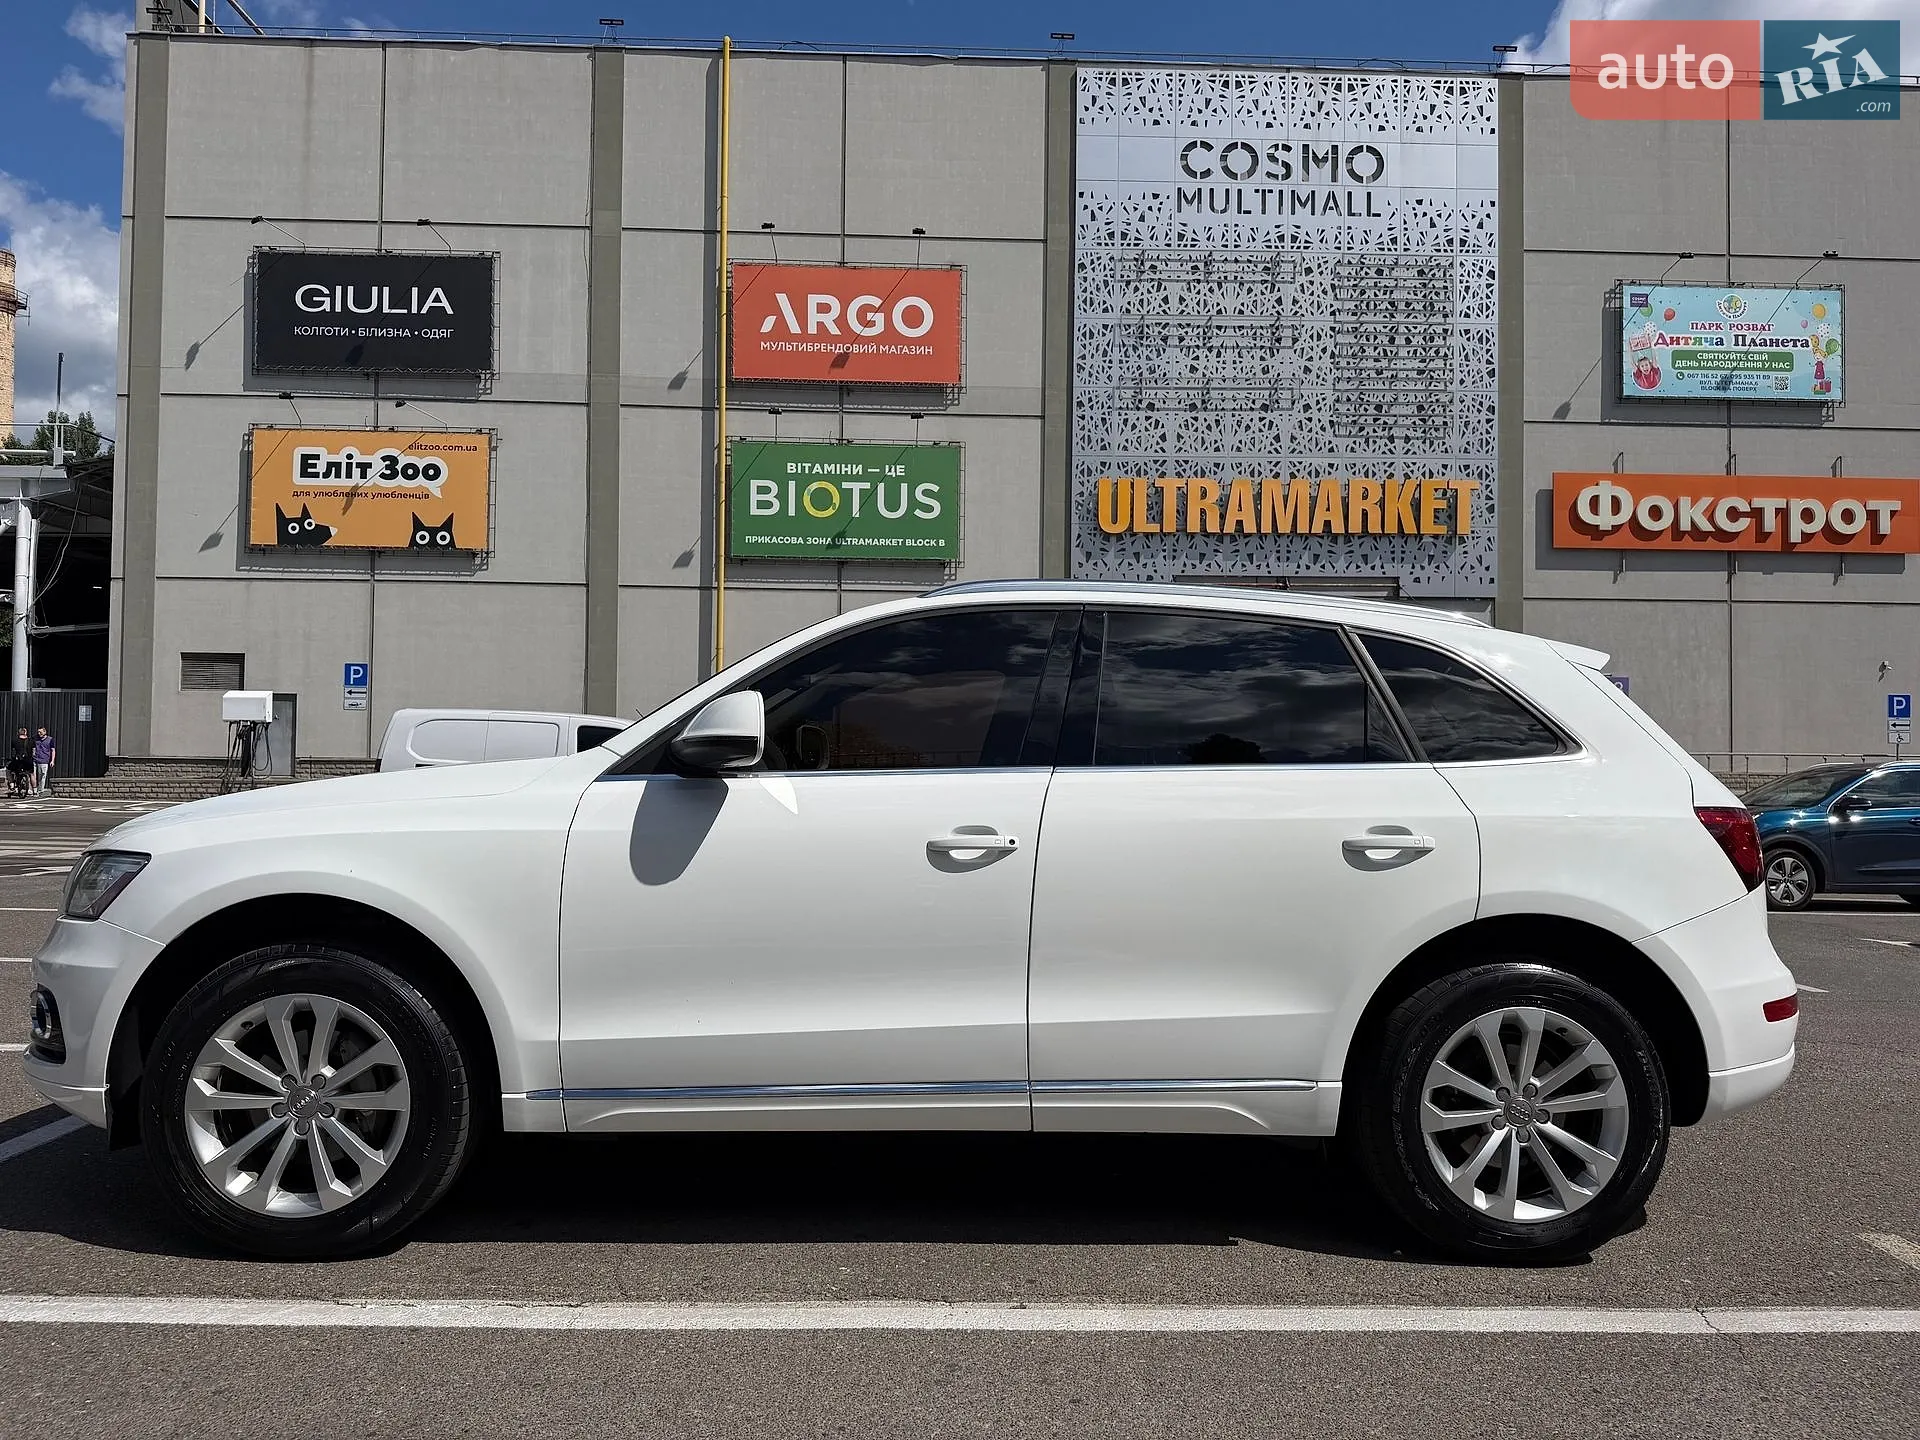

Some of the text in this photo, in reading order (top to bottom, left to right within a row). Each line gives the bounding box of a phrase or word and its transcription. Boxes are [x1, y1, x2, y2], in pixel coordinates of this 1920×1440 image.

[1180, 139, 1384, 184] COSMO
[1176, 186, 1382, 217] MULTIMALL
[294, 283, 454, 315] GIULIA
[759, 292, 934, 338] ARGO
[294, 326, 454, 339] КОЛГОТИ БІЛИЗНА ОДЯГ
[1690, 321, 1775, 333] ПАРК РОЗВАГ
[760, 341, 933, 356] МУЛЬТИБРЕНДОВИЙ МАГАЗИН
[1653, 333, 1725, 348] Дитяча
[1733, 334, 1810, 349] Планета
[1675, 359, 1790, 369] ДЕНЬ НАРОДЖЕННЯ У НАС
[1697, 351, 1768, 361] СВЯТКУЙТЕ СВІЙ
[408, 441, 478, 452] elitzoo.com.ua
[786, 462, 905, 477] ВІТАМІНИ ЦЕ
[292, 490, 430, 500] для улюблених улюбленців
[749, 478, 942, 520] BIOTUS
[1097, 476, 1480, 536] ULTRAMARKET
[1576, 480, 1902, 544] Фокстрот
[745, 535, 804, 545] ПРИКАСОВА
[806, 536, 832, 546] ЗОНА
[835, 537, 904, 547] ULTRAMARKET
[905, 538, 937, 547] BLOCK
[350, 666, 363, 684] P
[1893, 696, 1906, 716] P
